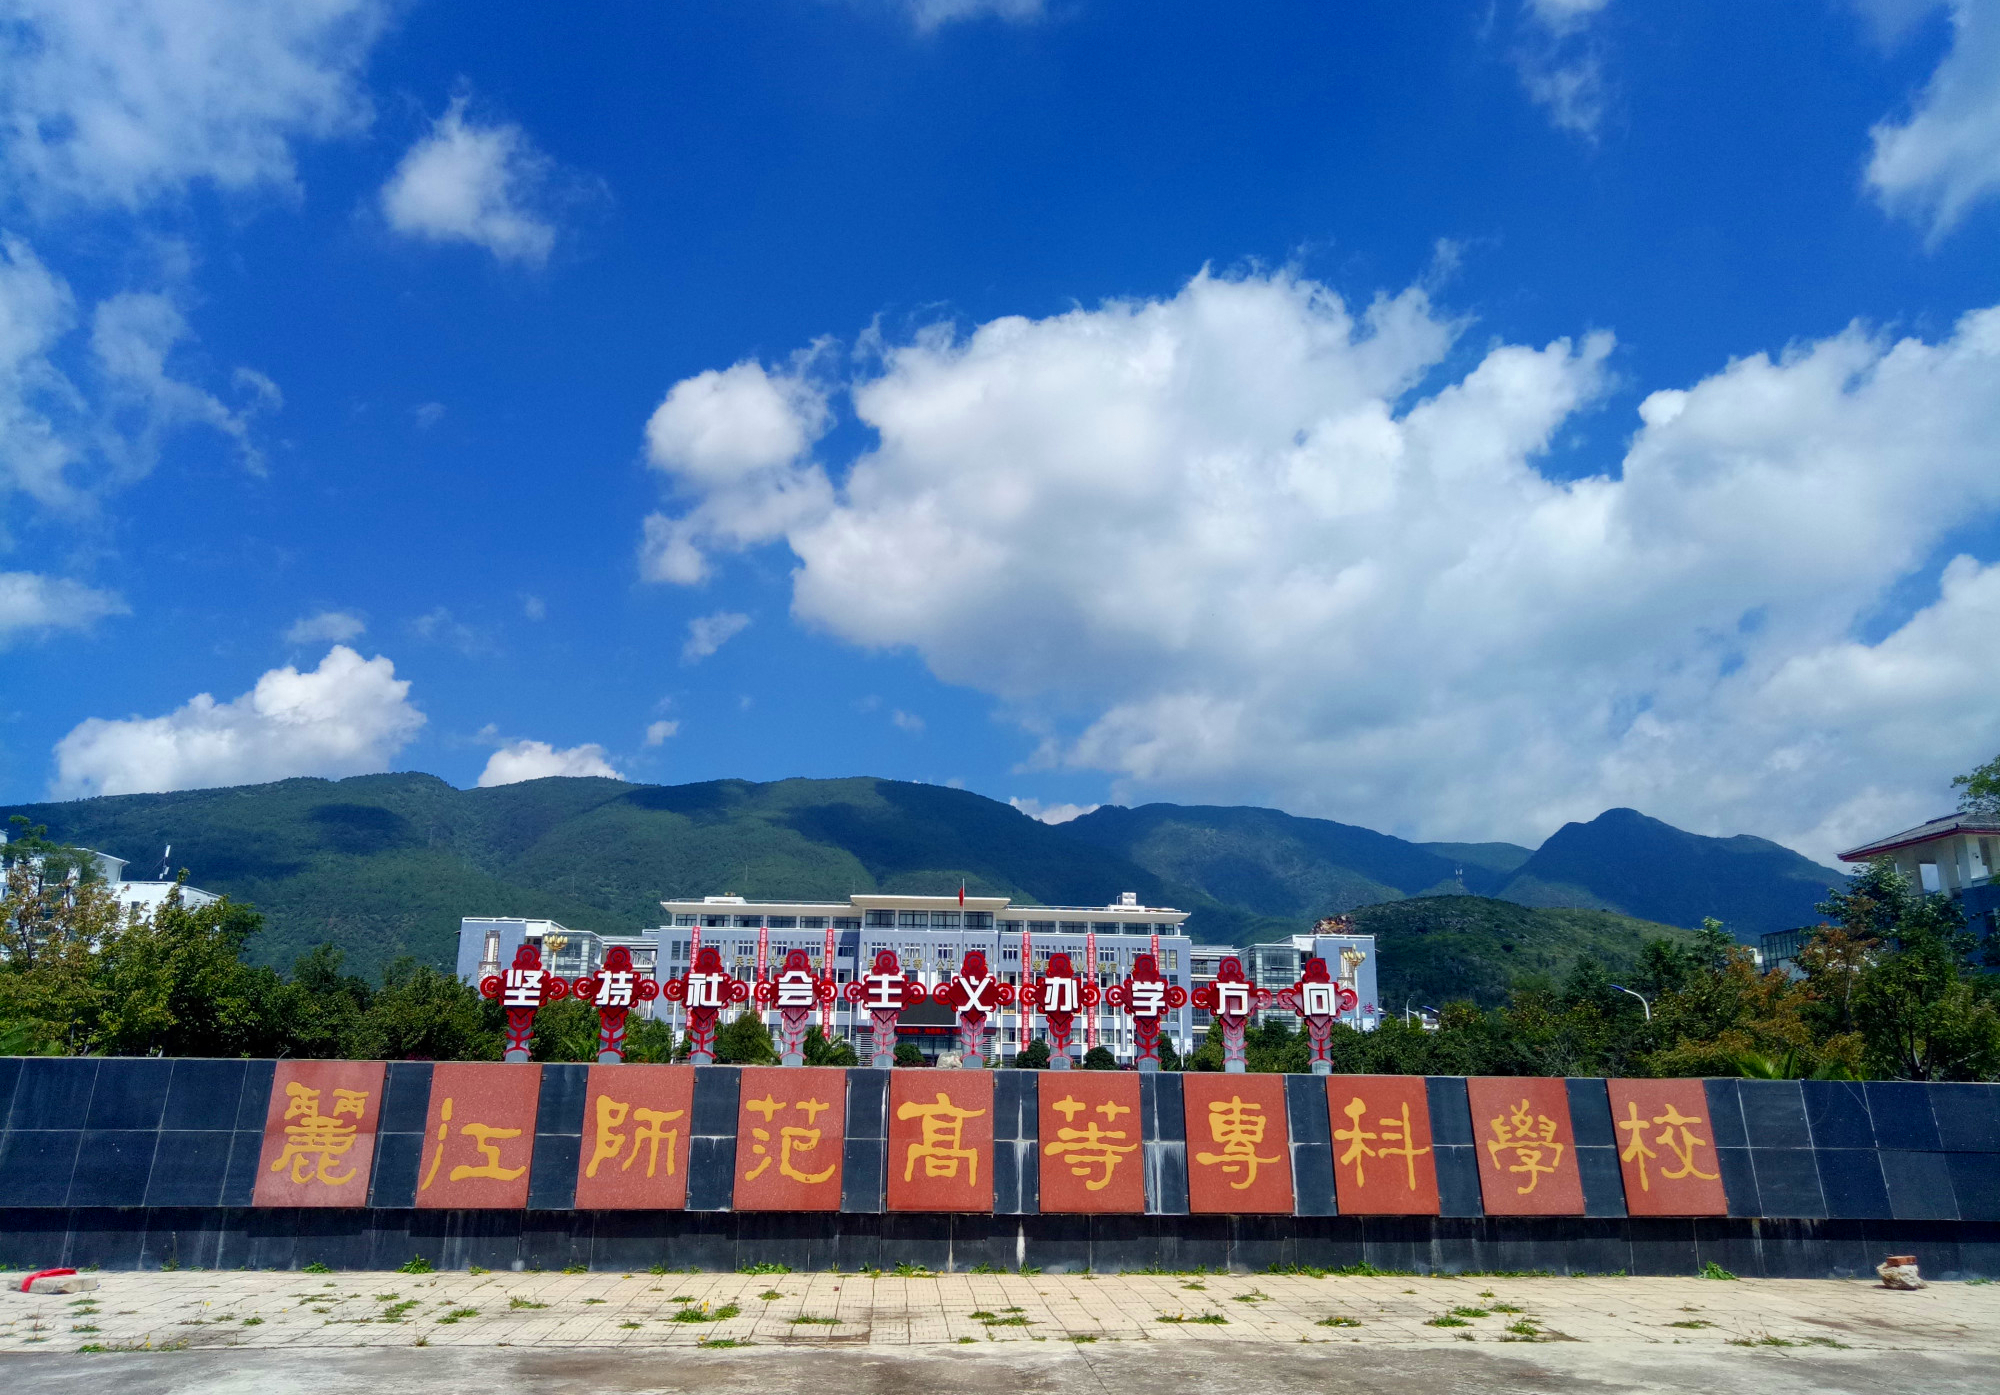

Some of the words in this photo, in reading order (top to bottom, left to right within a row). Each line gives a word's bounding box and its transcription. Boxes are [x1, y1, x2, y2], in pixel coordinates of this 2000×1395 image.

[503, 969, 1337, 1017] 坚持社会主义办学方向
